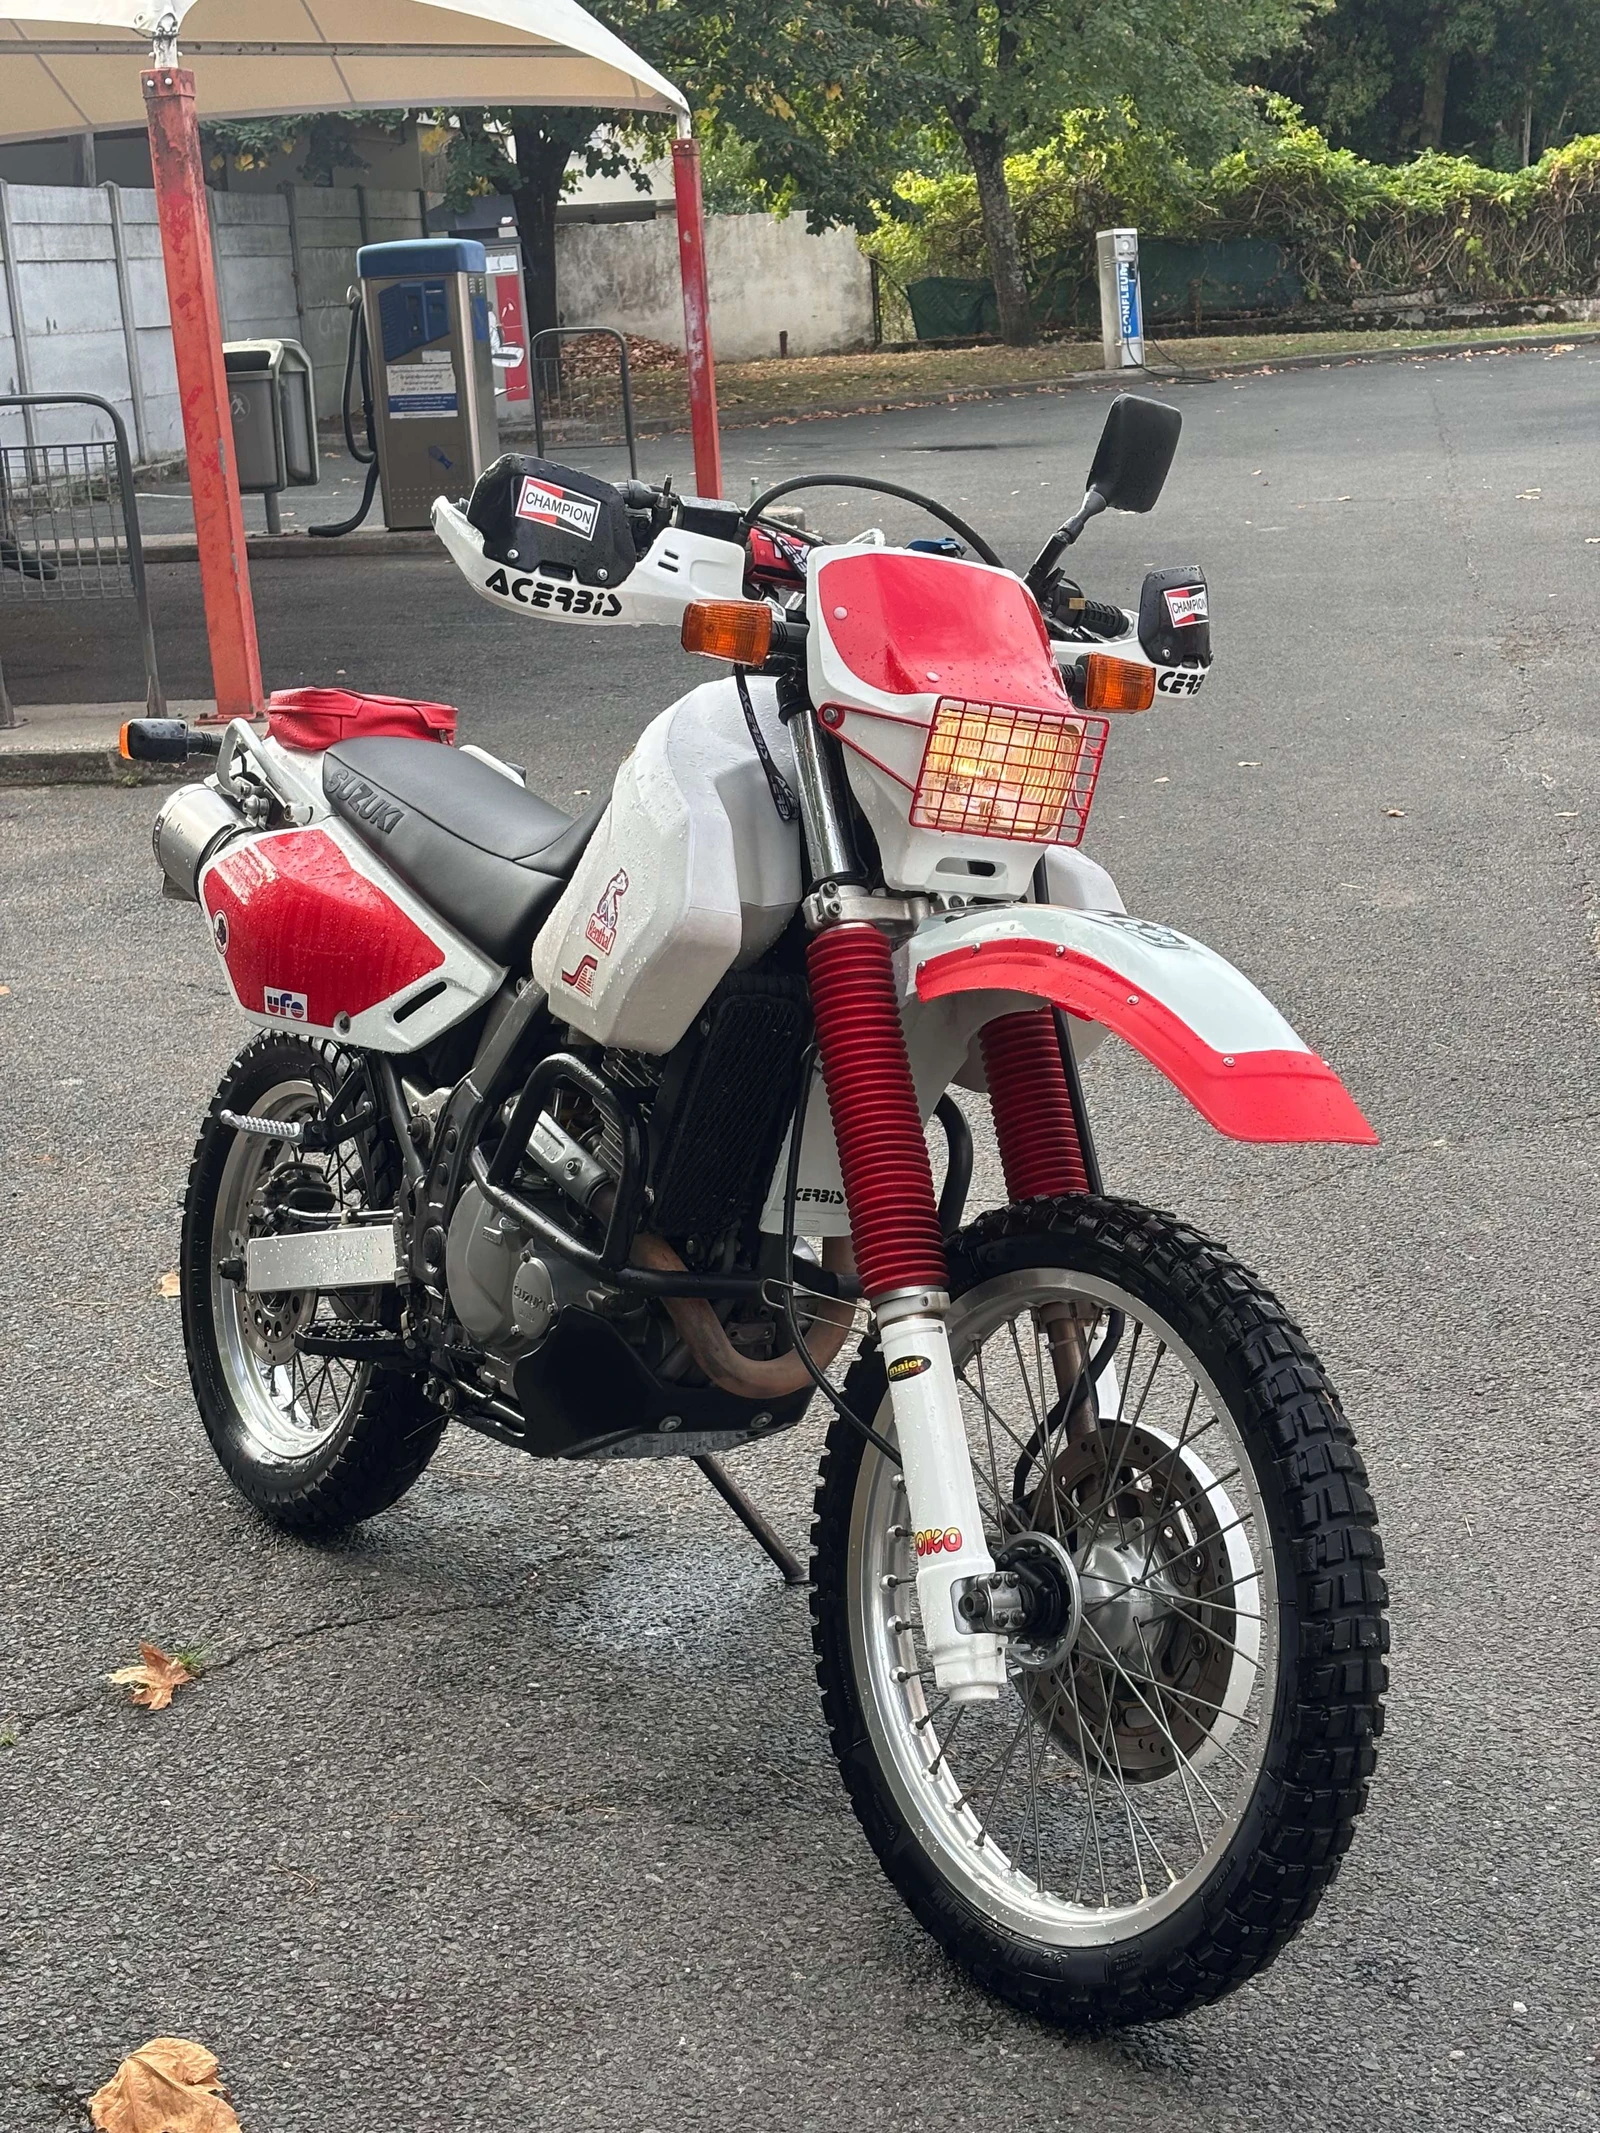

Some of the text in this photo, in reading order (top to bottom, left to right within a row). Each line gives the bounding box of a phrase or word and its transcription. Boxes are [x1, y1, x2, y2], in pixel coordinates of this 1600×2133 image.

[526, 492, 592, 524] CHAMPION
[325, 768, 405, 834] SUZUKI
[587, 919, 613, 950] Renthal
[889, 1358, 924, 1376] maier
